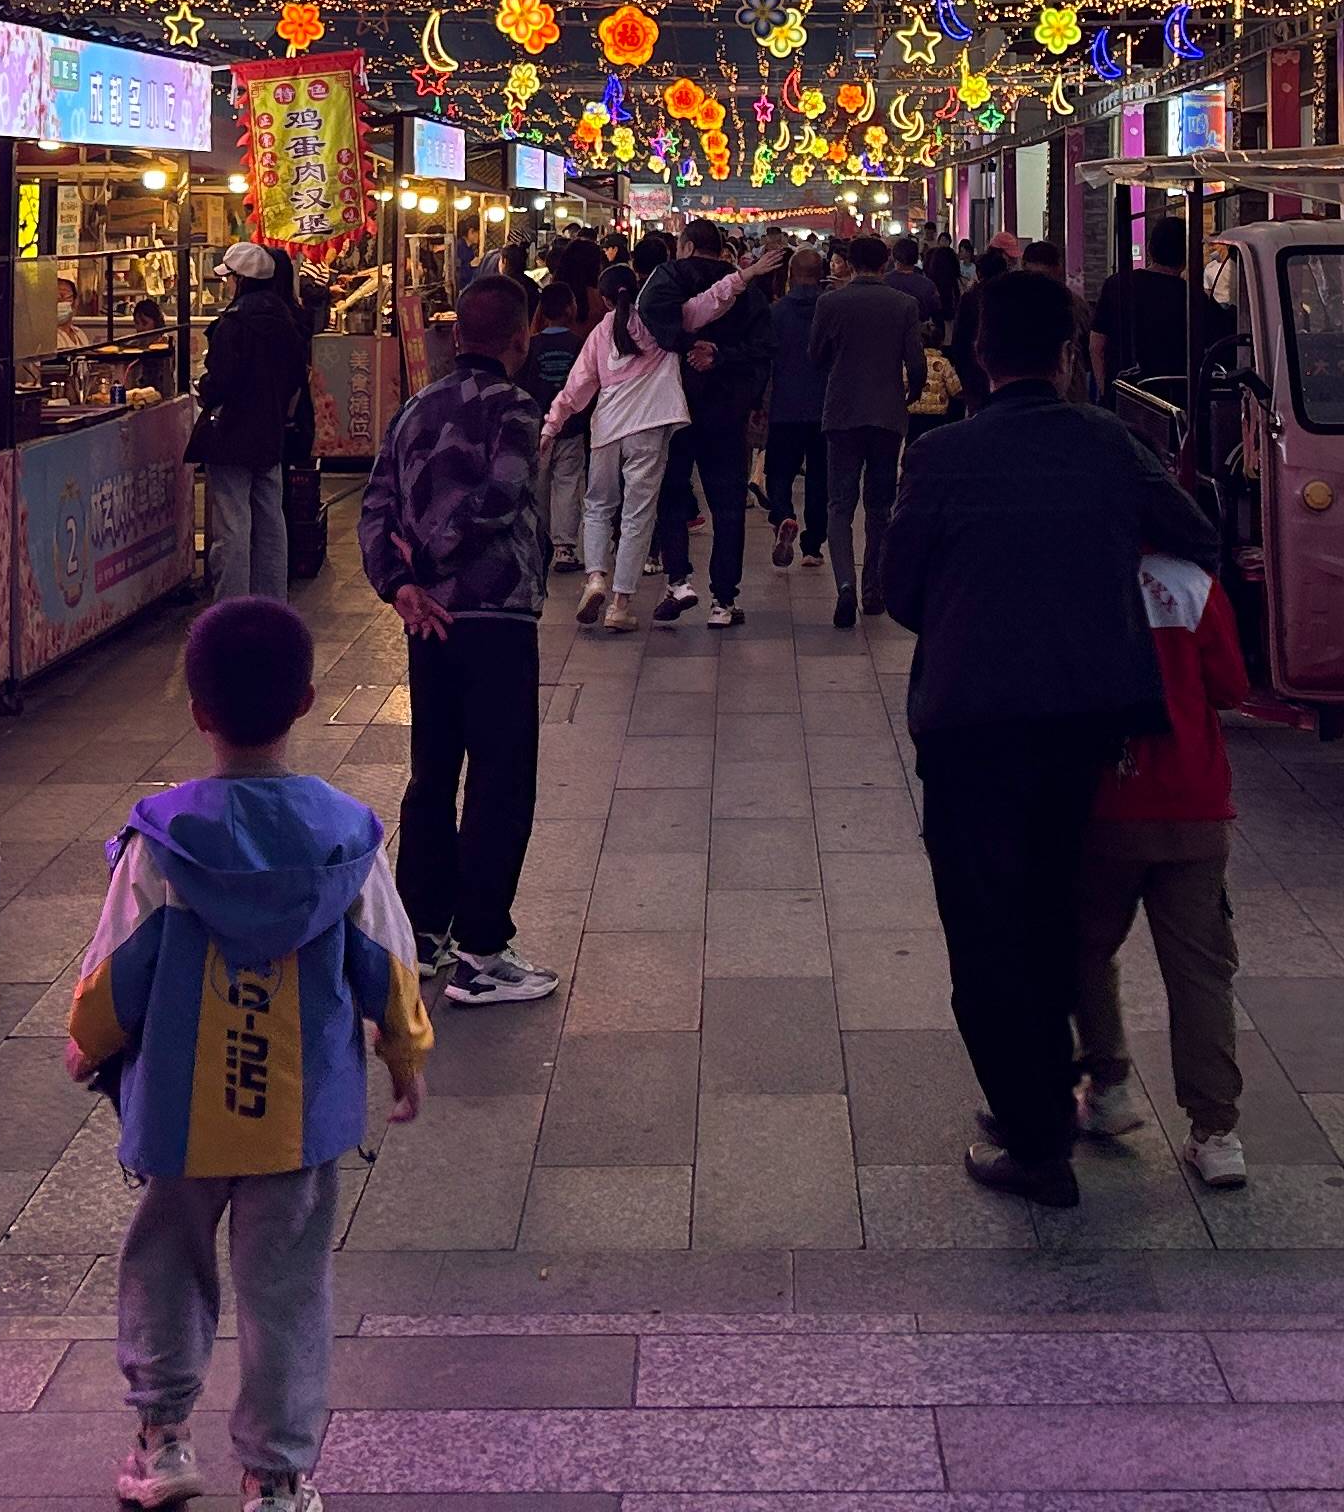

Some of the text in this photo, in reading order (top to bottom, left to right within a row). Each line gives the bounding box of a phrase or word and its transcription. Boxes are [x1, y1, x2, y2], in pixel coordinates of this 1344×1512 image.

[88, 71, 177, 132] 成都名小吃
[283, 108, 335, 238] 鸡蛋肉汉堡
[65, 516, 79, 577] 2
